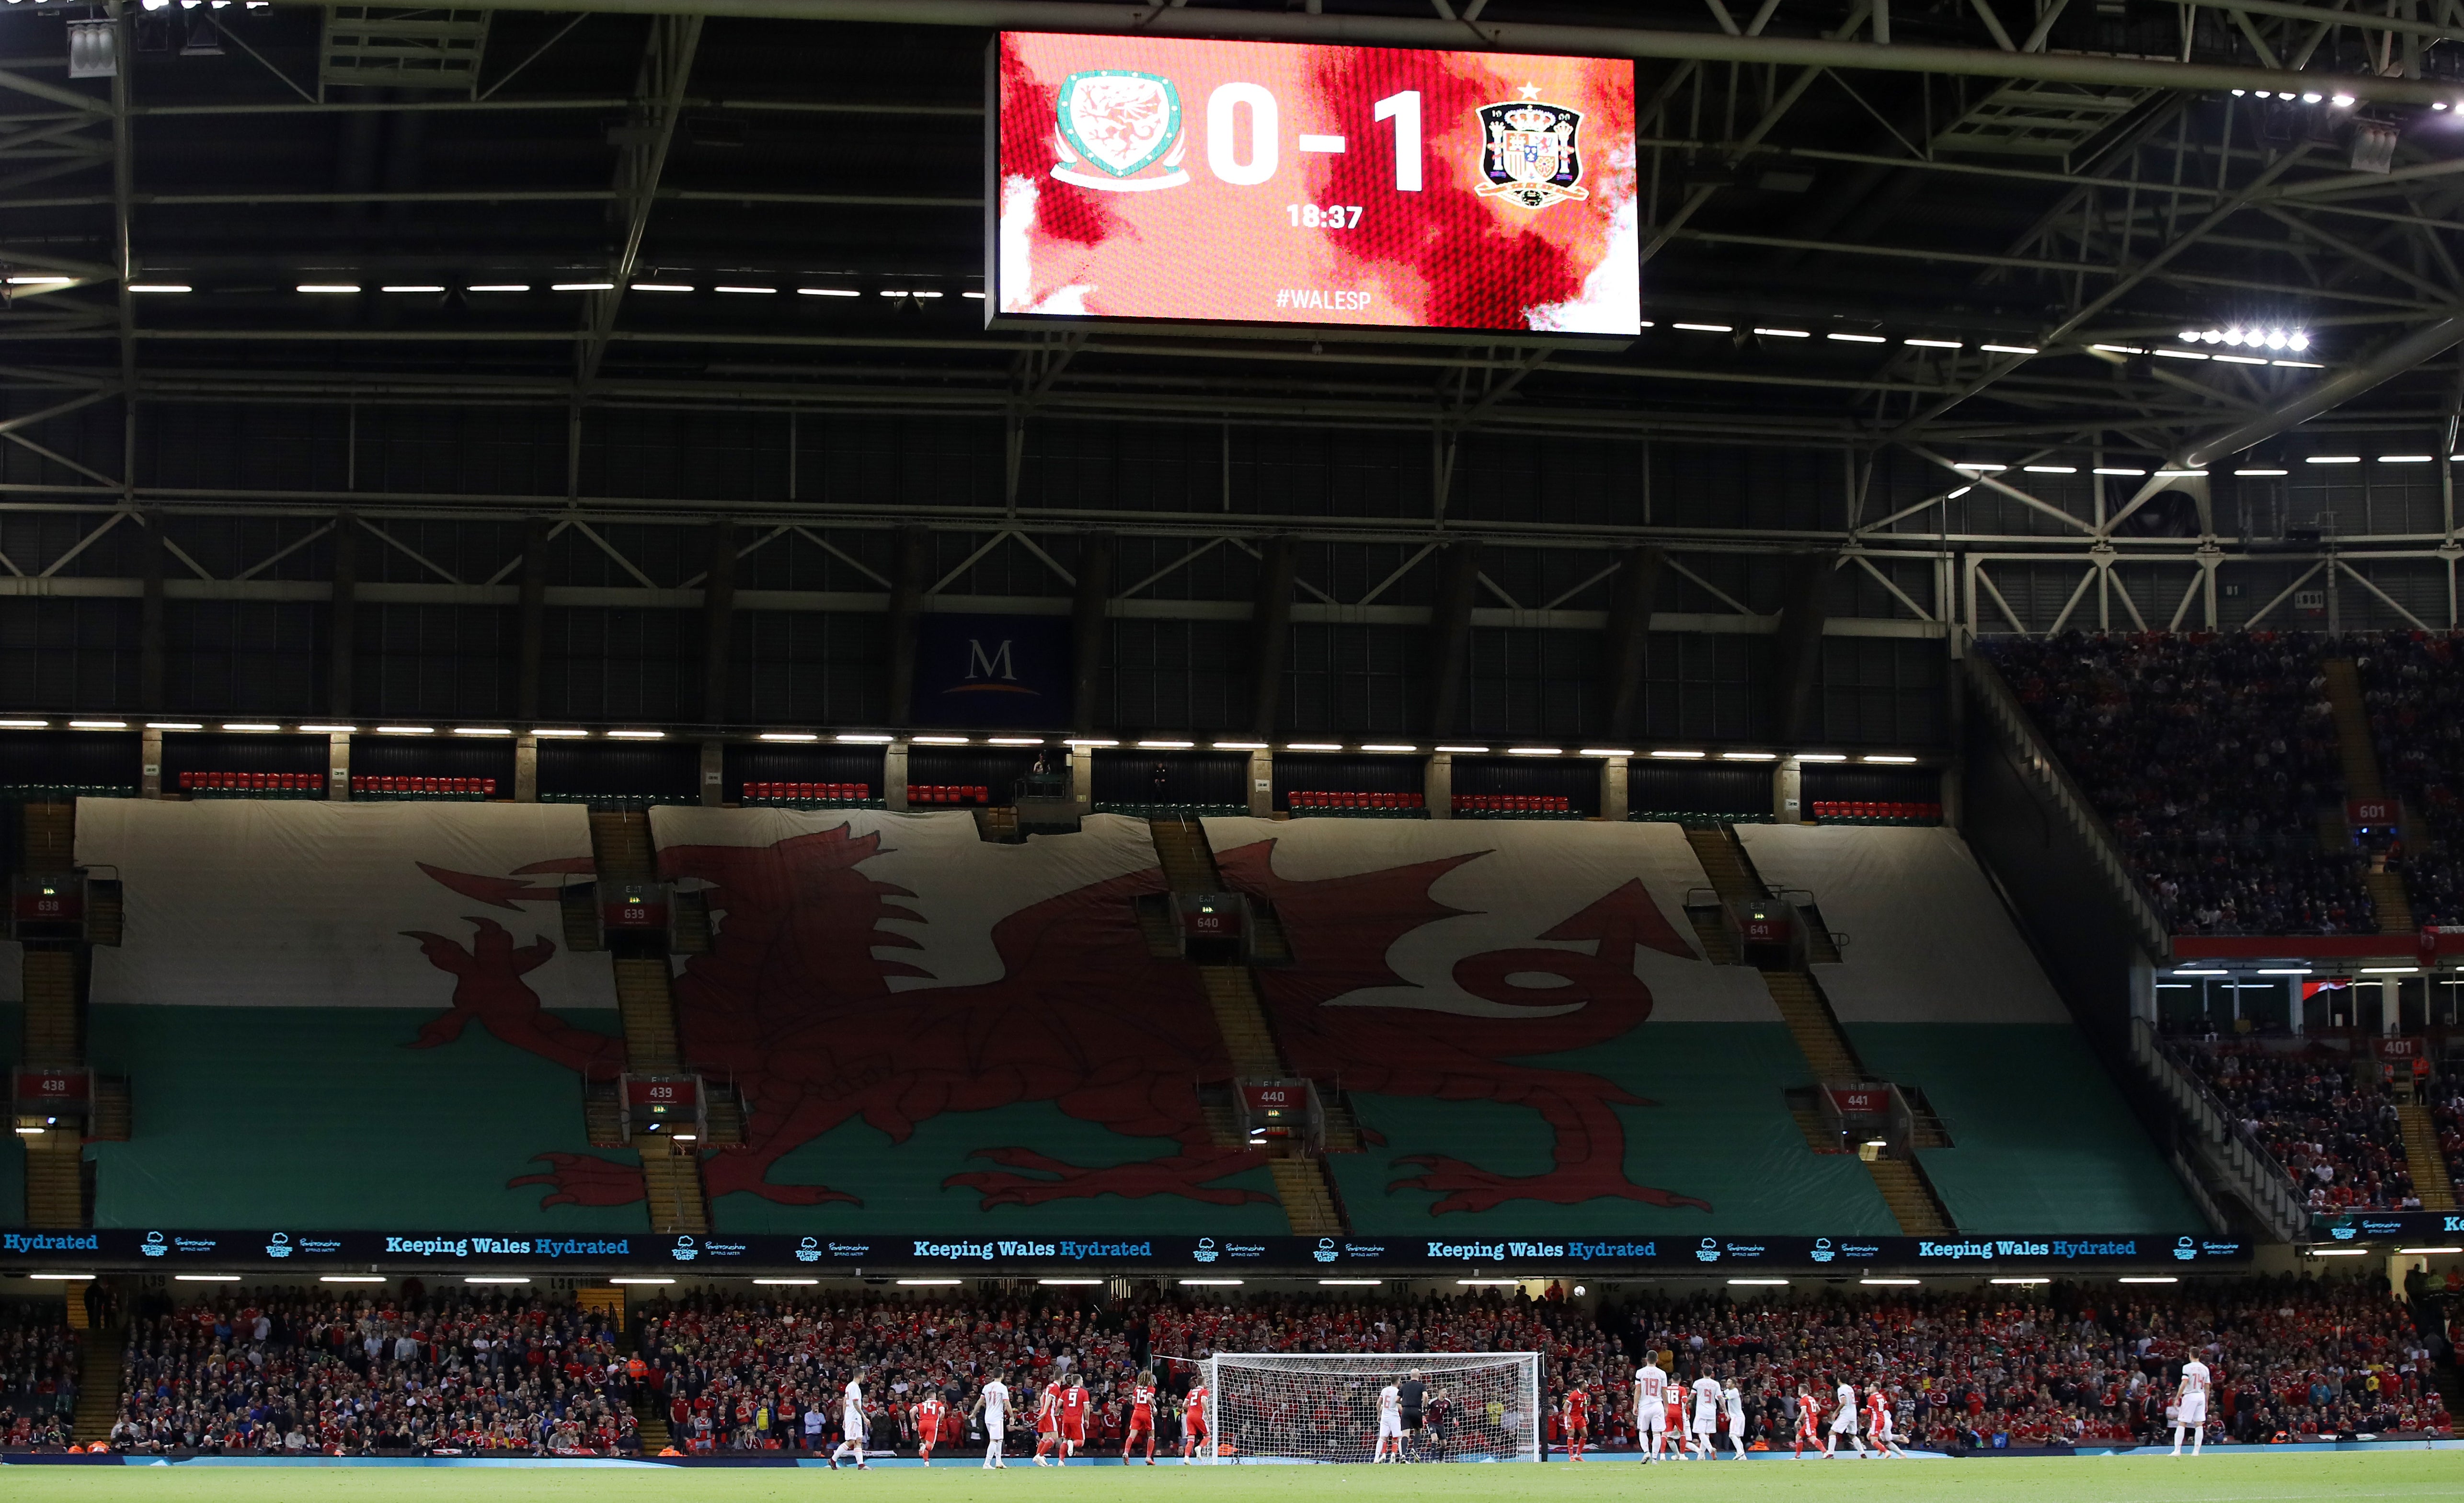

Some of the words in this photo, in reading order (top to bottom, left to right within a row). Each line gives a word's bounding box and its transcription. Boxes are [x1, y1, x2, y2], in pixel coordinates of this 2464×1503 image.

[1206, 81, 1281, 186] 0
[1375, 91, 1422, 192] 1
[1286, 204, 1363, 229] 18:37
[1276, 289, 1371, 311] #WALESP
[964, 639, 1017, 680] M
[2360, 805, 2385, 818] 601
[38, 901, 58, 911] 638
[624, 909, 644, 919] 639
[1198, 918, 1218, 928] 640
[1750, 925, 1768, 934] 641
[2385, 1041, 2411, 1054] 401
[42, 1080, 65, 1091] 438
[650, 1087, 673, 1098] 439
[1261, 1091, 1284, 1102] 440
[1848, 1095, 1868, 1106] 441
[3, 1234, 99, 1253] Hydrated
[386, 1236, 468, 1257] Keeping
[471, 1238, 531, 1254] Wales
[535, 1239, 630, 1258] Hydrated
[914, 1240, 994, 1260] Keeping
[997, 1241, 1055, 1256] Wales
[1060, 1240, 1152, 1260] Hydrated
[1427, 1241, 1505, 1261] Keeping
[1508, 1242, 1564, 1257] Wales
[1568, 1241, 1657, 1261] Hydrated
[1919, 1240, 1993, 1259] Keeping
[1996, 1241, 2049, 1255] Wales
[2052, 1240, 2137, 1259] Hydrated
[1643, 1377, 1659, 1396] 18
[1068, 1392, 1077, 1407] 9
[1136, 1388, 1147, 1404] 15
[1190, 1391, 1198, 1406] 2
[1384, 1395, 1390, 1409] 6
[1666, 1389, 1680, 1404] 18
[1704, 1388, 1712, 1404] 9
[923, 1402, 936, 1415] 14
